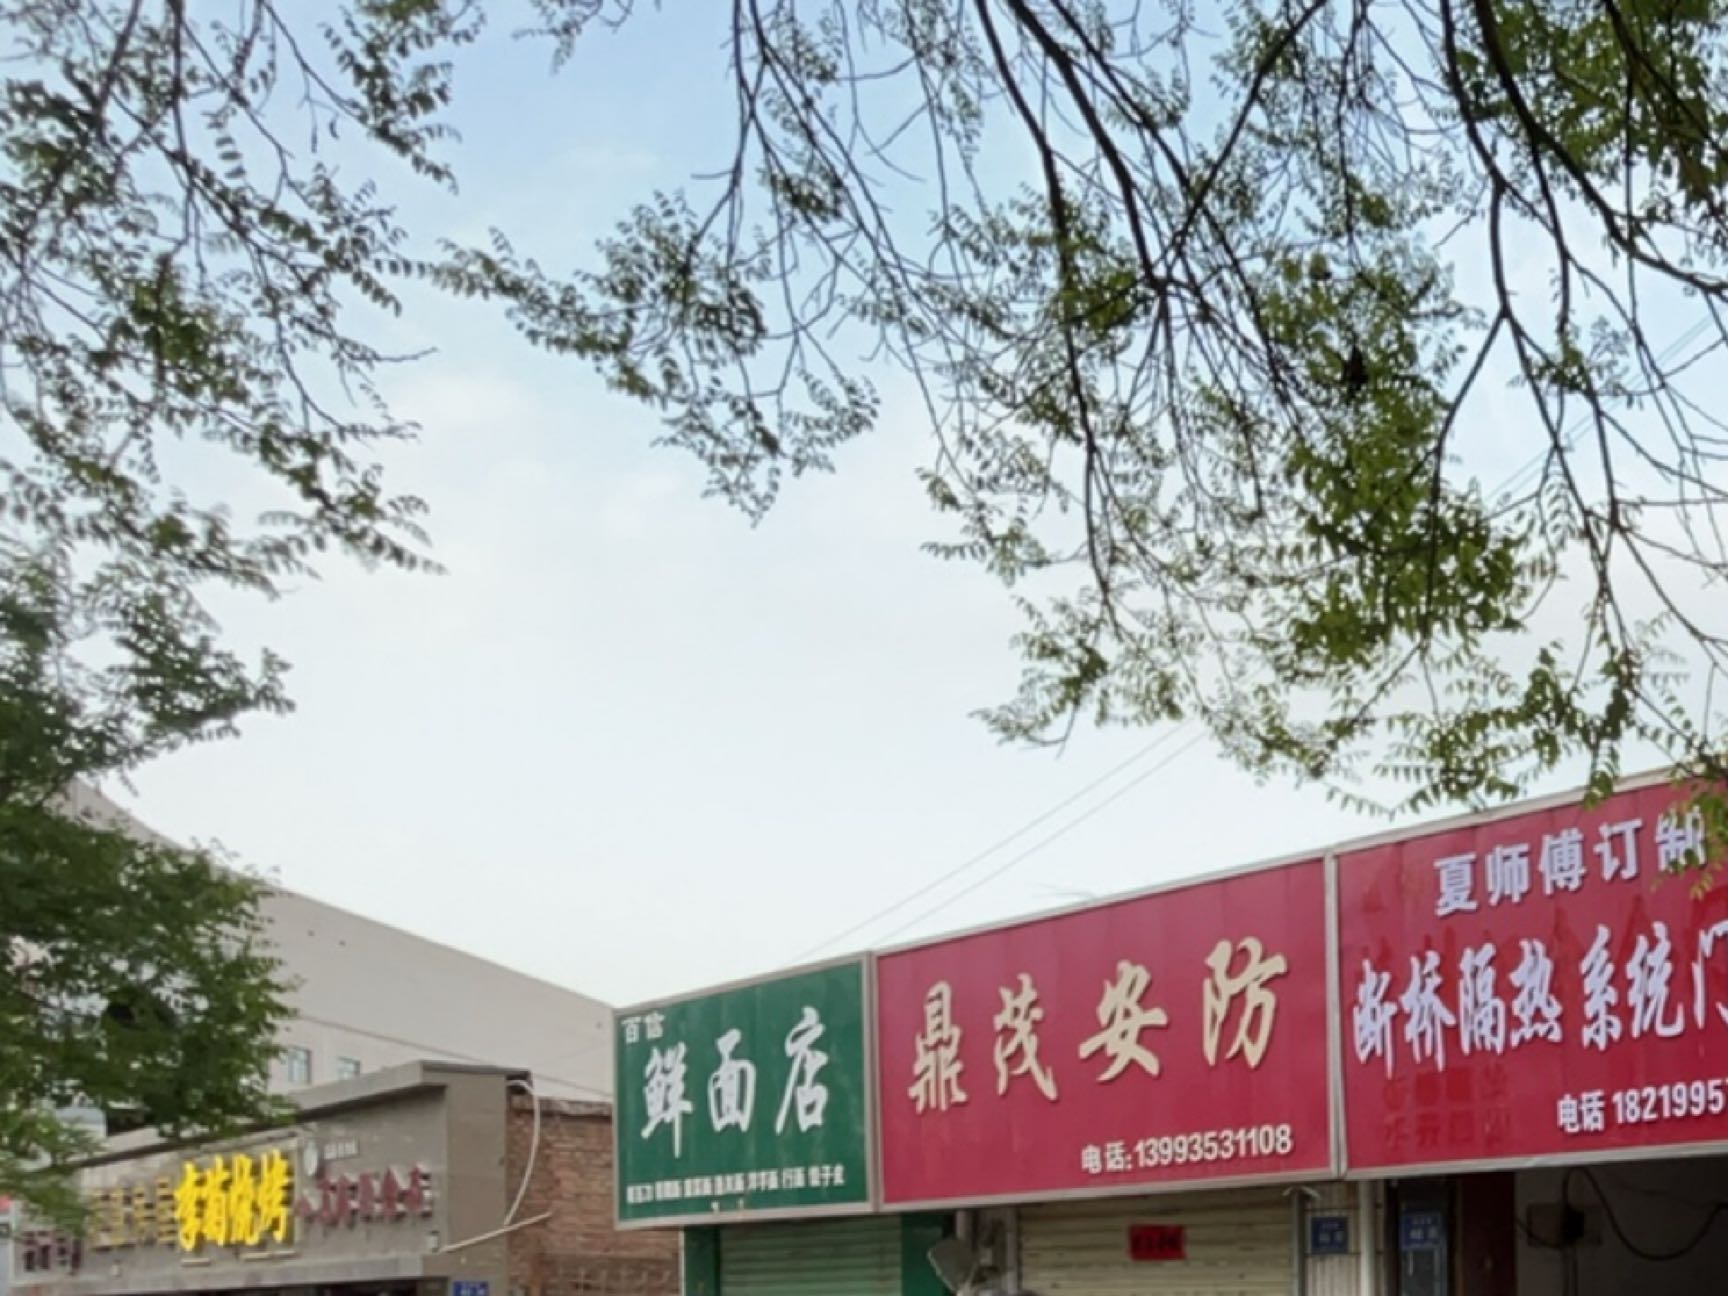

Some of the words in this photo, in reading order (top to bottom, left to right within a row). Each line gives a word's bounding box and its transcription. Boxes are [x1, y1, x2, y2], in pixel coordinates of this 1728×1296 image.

[1434, 805, 1706, 916] 夏师傅订制
[908, 936, 1288, 1114] 鼎茂安防
